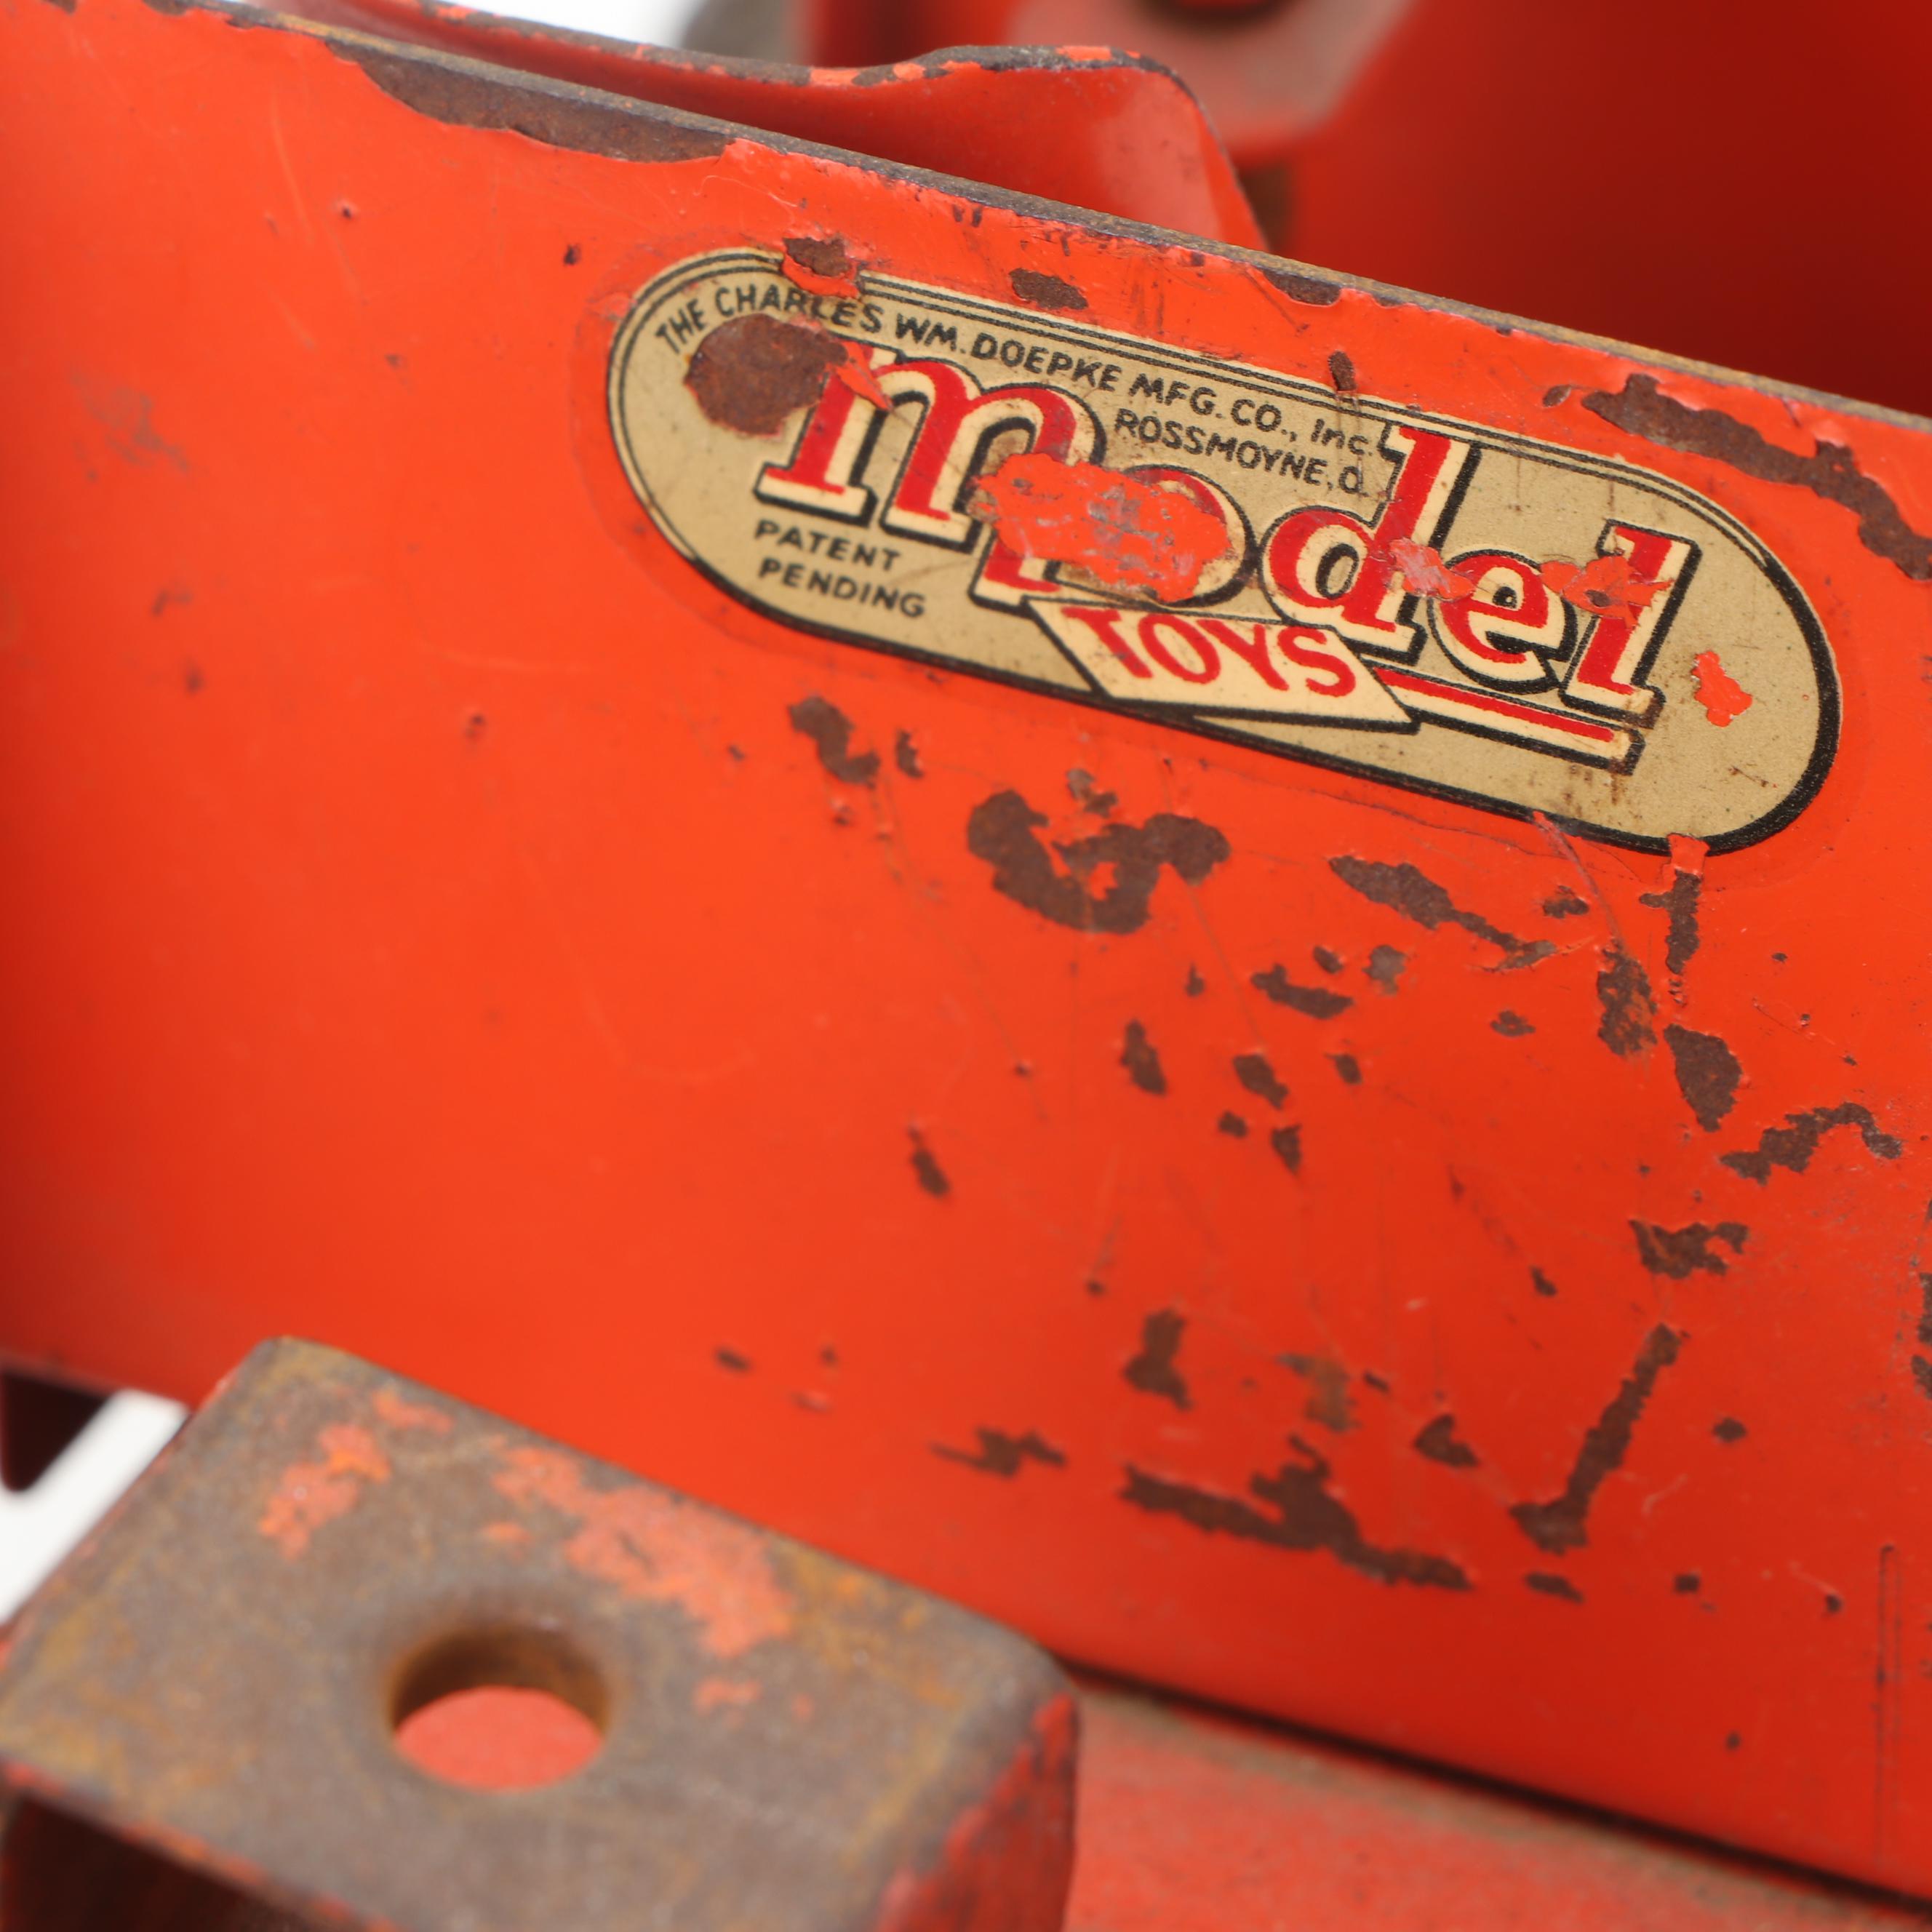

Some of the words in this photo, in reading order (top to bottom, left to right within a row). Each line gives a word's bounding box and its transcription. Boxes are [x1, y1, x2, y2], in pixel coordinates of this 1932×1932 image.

[655, 298, 707, 355] THE
[714, 283, 885, 334] CHARLES
[1311, 418, 1373, 458] Inc.
[753, 518, 902, 572] PATENT
[757, 556, 927, 619] PENDING
[1061, 606, 1357, 698] TOYS
